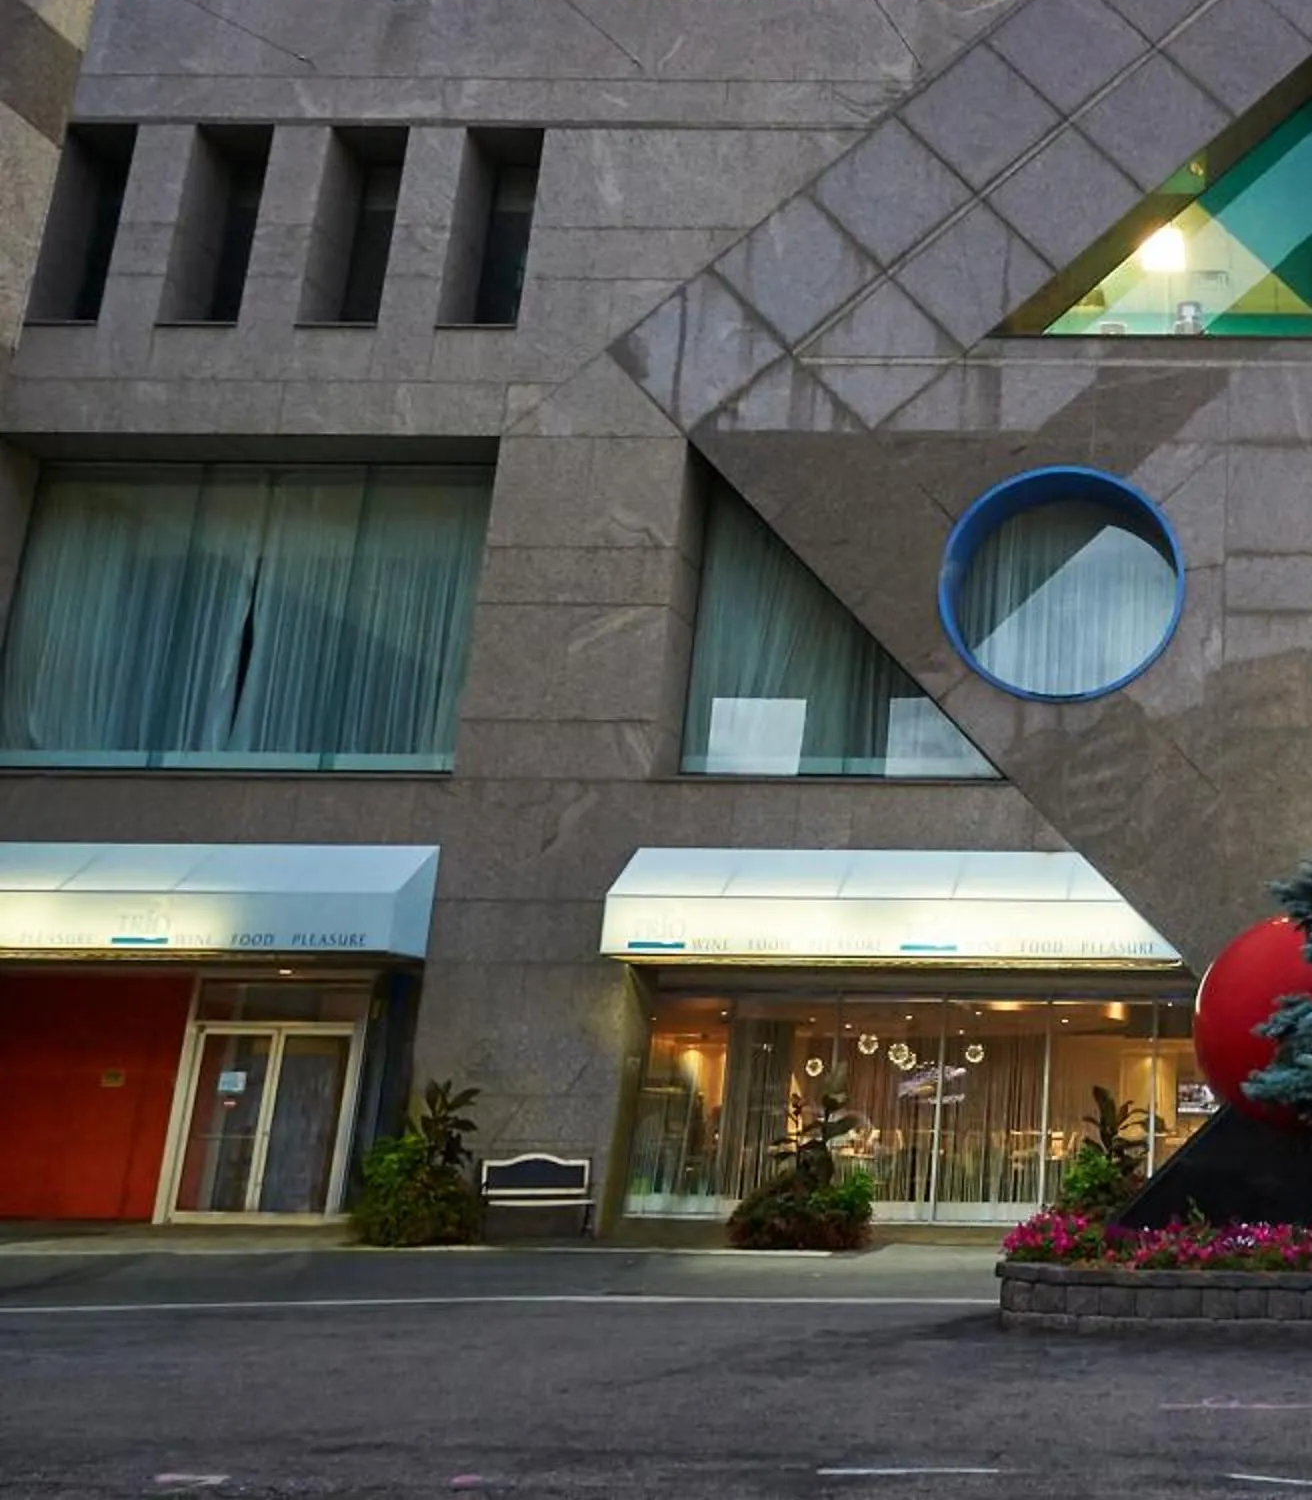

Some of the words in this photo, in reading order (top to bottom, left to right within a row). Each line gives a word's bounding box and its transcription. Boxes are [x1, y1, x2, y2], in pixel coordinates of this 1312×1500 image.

[230, 933, 275, 947] FOOD
[292, 933, 367, 947] PLEASURE
[692, 938, 730, 951] WINE
[1020, 940, 1064, 954] FOOD
[1081, 940, 1155, 955] PLEASURE
